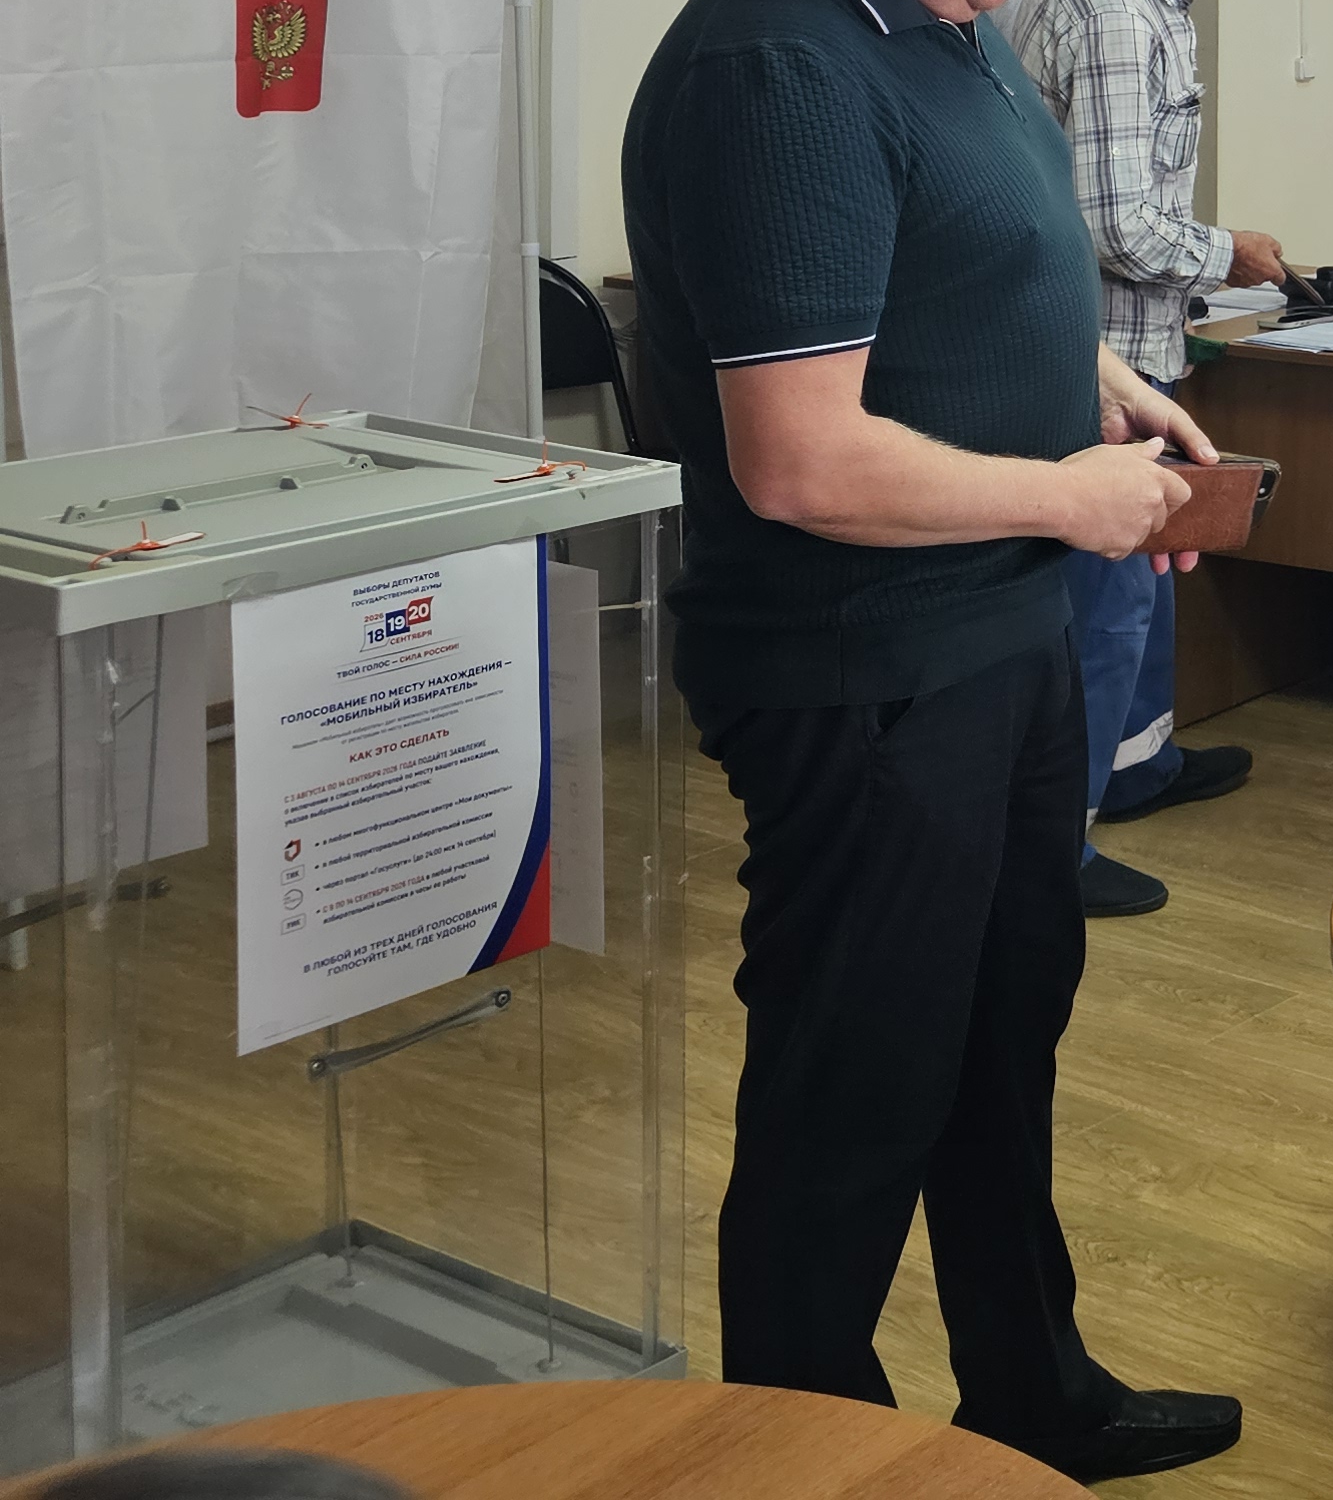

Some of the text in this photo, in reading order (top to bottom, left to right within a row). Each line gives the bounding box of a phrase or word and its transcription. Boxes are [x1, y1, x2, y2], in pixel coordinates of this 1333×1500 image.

[353, 570, 440, 596] ВЫБОРЫ ДЕПУТАТОВ
[386, 612, 406, 633] 19
[407, 600, 430, 622] 20
[367, 628, 384, 643] 18
[389, 629, 432, 645] СЕНТЯБРЯ
[336, 665, 360, 678] ТВОЙ
[361, 659, 390, 672] ГОЛОС
[399, 652, 421, 663] СИЛА
[423, 643, 459, 657] РОССИИ!
[280, 695, 367, 725] ГОЛОСОВАНИЕ
[369, 690, 385, 702] ПО
[388, 680, 425, 697] МЕСТУ
[428, 660, 502, 687] НАХОЖДЕНИЯ
[320, 698, 400, 726] «МОБИЛЬНЫЙ
[403, 681, 477, 706] ИЗБИРАТЕЛЬ»
[349, 729, 449, 762] КАК ЭТО СДЕЛАТЬ
[303, 901, 497, 973] В ЛЮБОЙ ИЗ ТРЕХ ДНЕЙ ГОЛОСОВАНИЯ
[327, 919, 476, 976] ГОЛОСУЙТЕ ТАМ, ГДЕ УДОБНО
